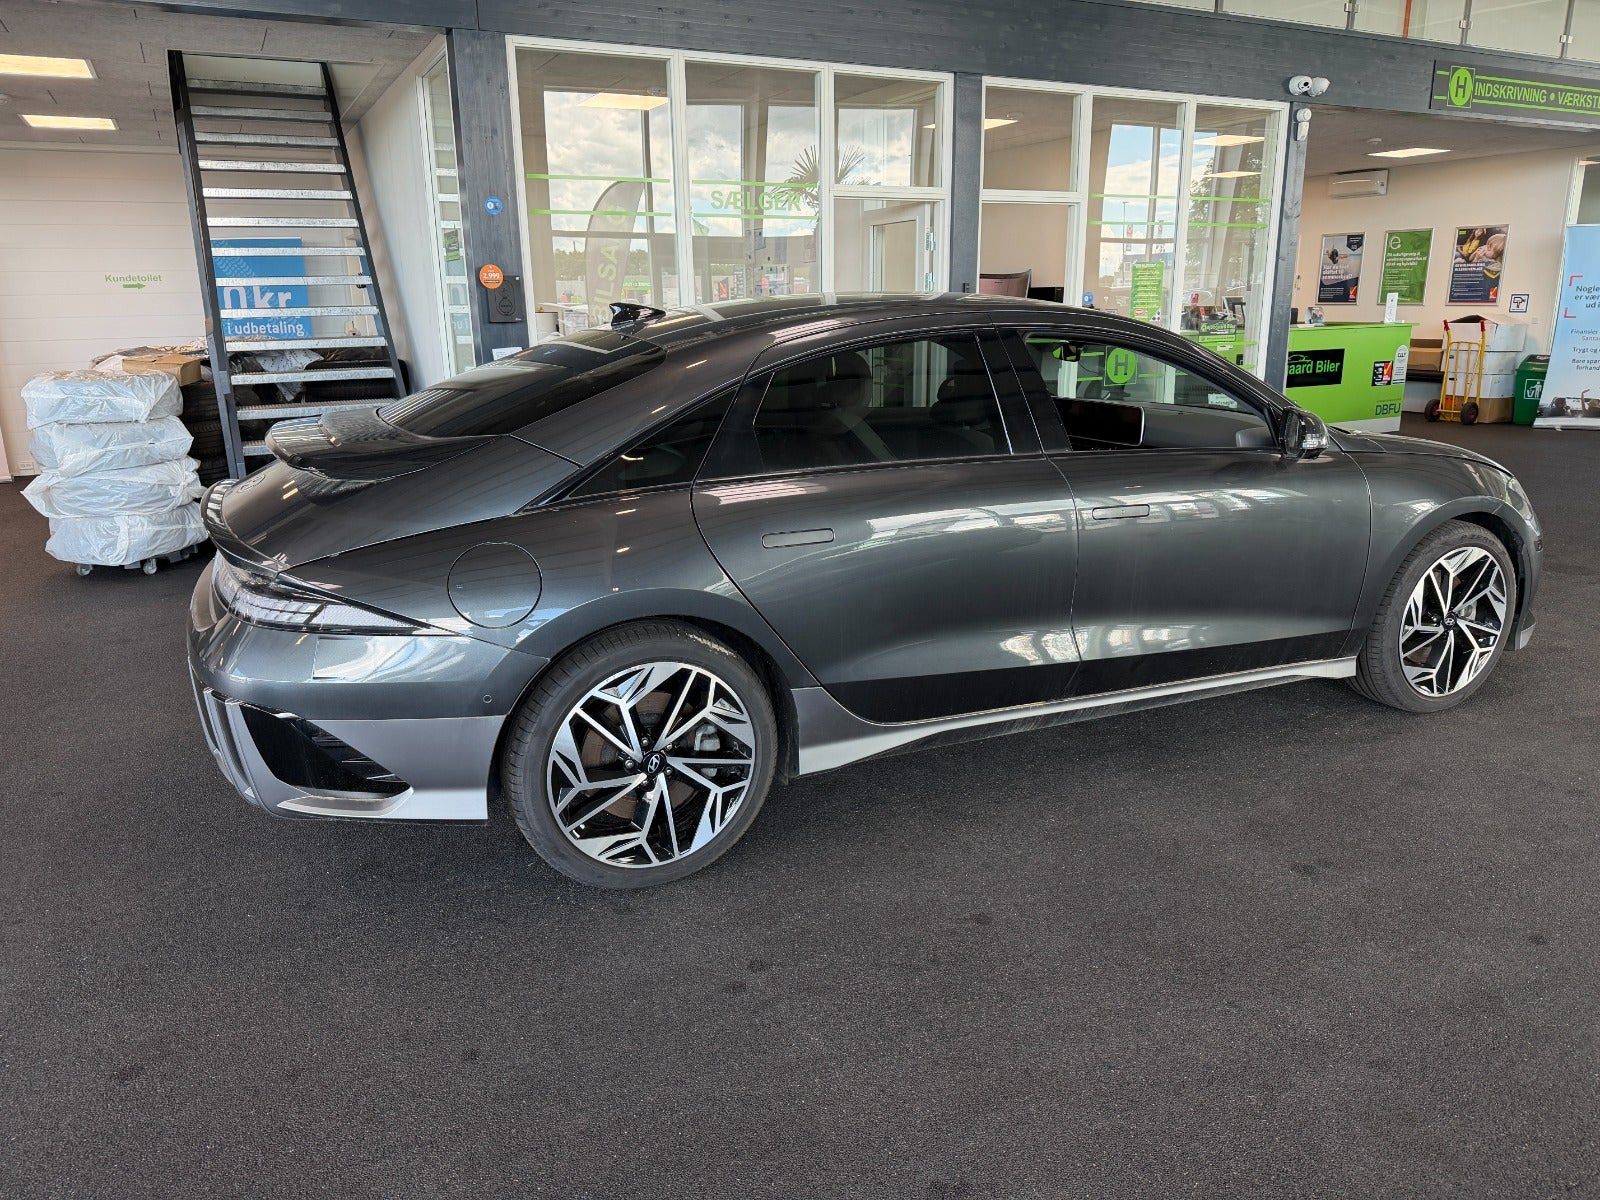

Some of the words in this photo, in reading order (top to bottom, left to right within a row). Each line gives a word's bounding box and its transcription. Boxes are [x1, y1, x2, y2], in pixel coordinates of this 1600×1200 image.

[1454, 75, 1468, 99] H
[1474, 81, 1548, 103] INDSKRIVNING
[710, 190, 802, 211] SÆLGER
[104, 273, 163, 283] Kundetoilet
[1585, 301, 1597, 309] ud
[234, 321, 305, 337] udbetaling
[1113, 354, 1128, 376] H
[1287, 360, 1314, 375] aard
[1315, 359, 1341, 373] Biler
[1375, 402, 1401, 416] DBFU
